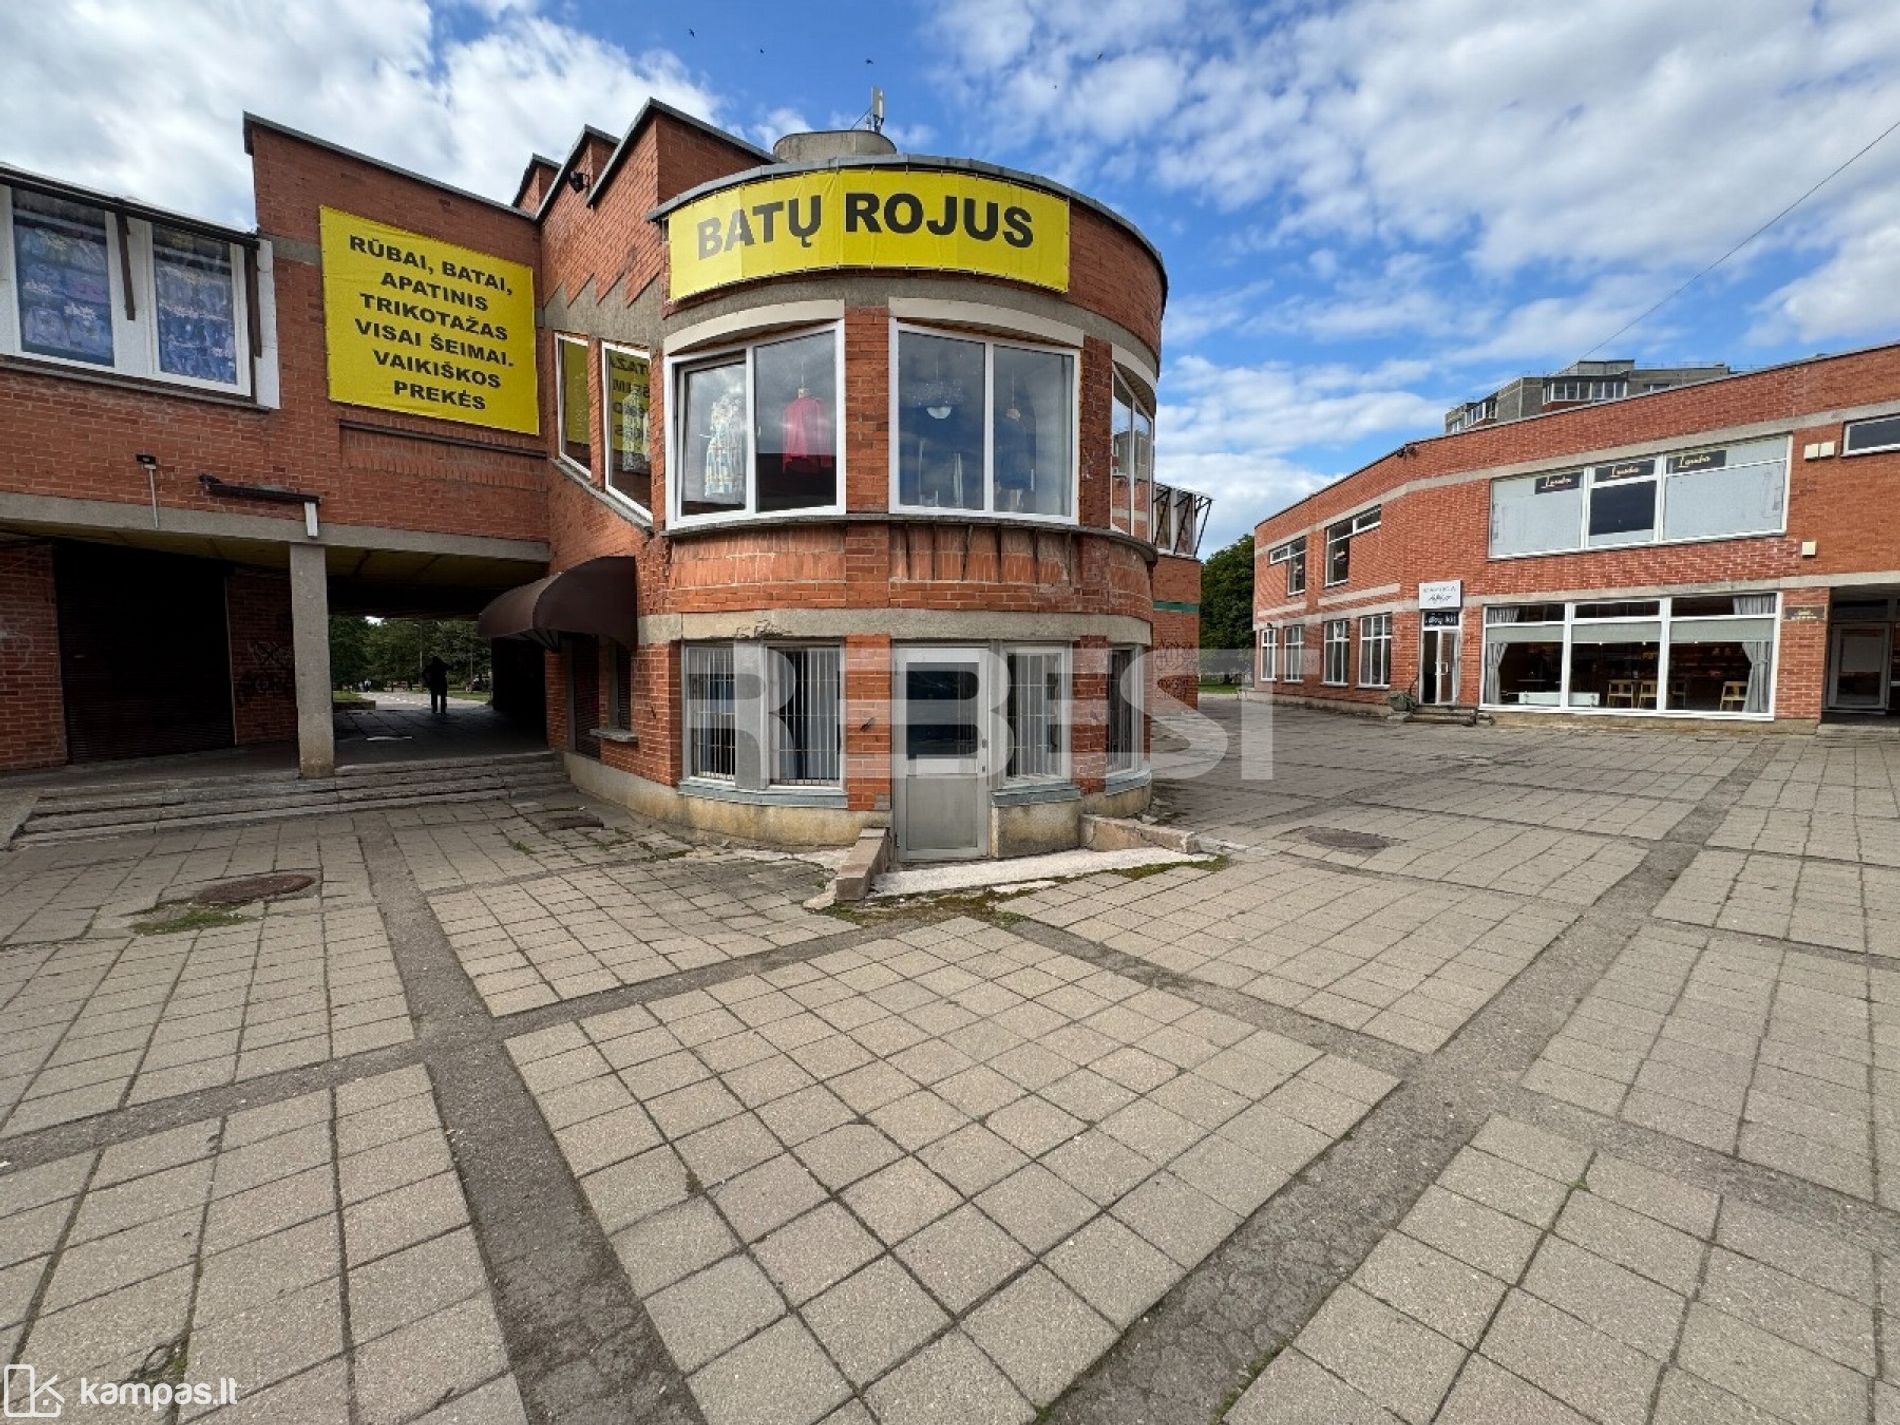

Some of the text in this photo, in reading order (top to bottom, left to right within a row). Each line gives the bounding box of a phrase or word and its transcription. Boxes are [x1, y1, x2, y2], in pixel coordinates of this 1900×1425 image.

[697, 193, 1034, 261] BATŲ ROJUS
[350, 235, 513, 296] RŪBAI, BATAI,
[381, 272, 488, 311] APATINIS
[360, 292, 508, 341] TRIKOTAŽAS
[355, 318, 514, 367] VISAI ŠEIMAI.
[373, 350, 501, 389] VAIKIŠKOS
[393, 380, 486, 410] PREKĖS
